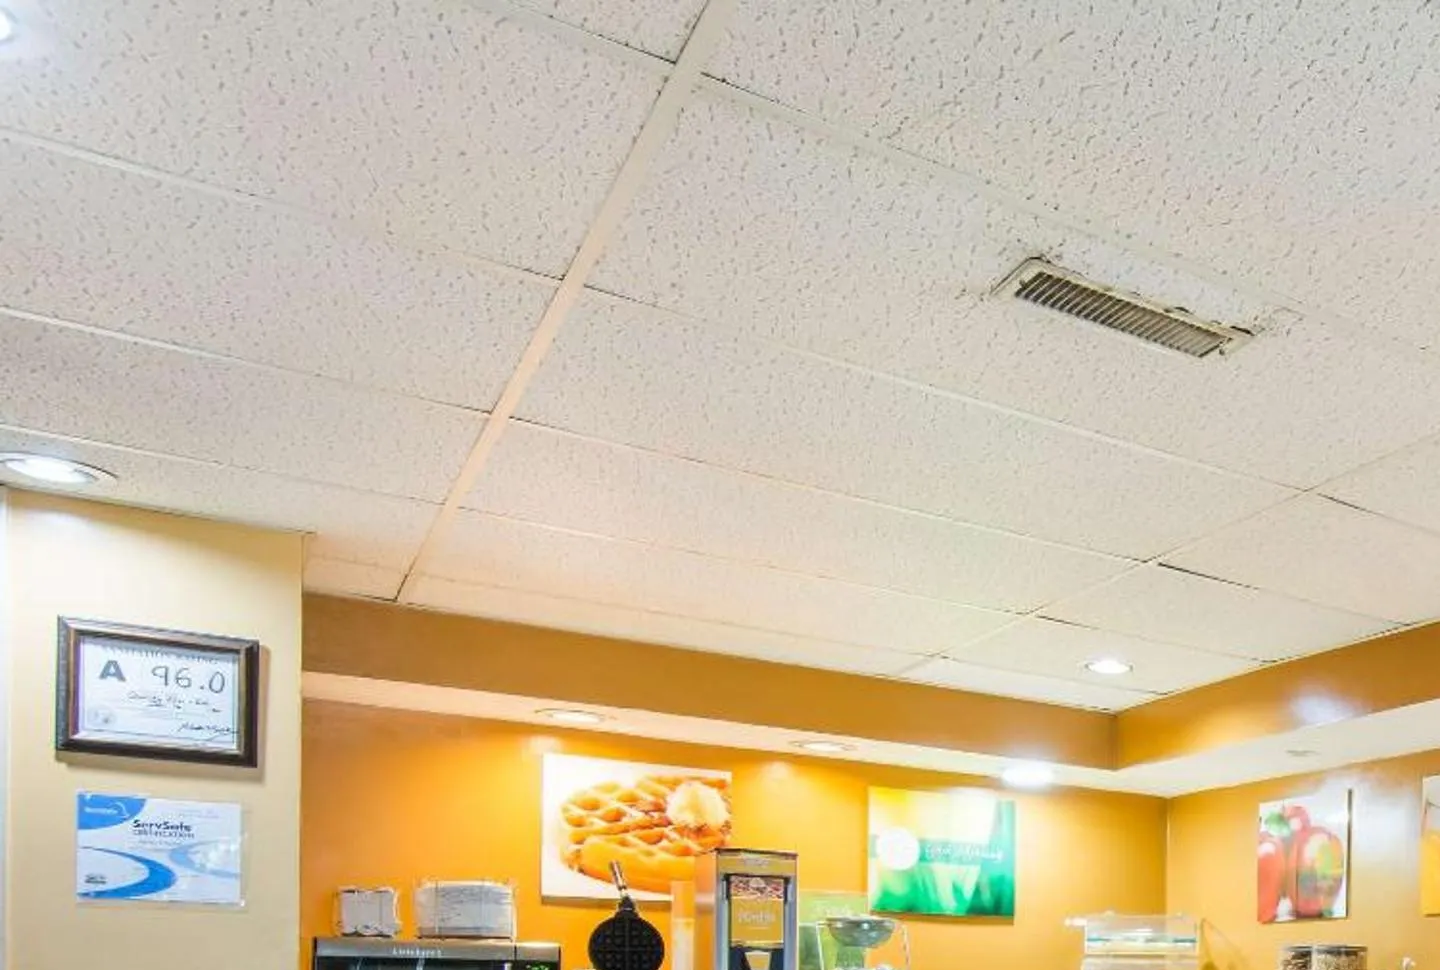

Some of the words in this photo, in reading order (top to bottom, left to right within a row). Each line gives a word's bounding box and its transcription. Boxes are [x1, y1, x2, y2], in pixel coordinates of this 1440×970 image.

[99, 660, 126, 682] A
[152, 665, 225, 694] 96.0
[133, 819, 192, 832] ServSafe
